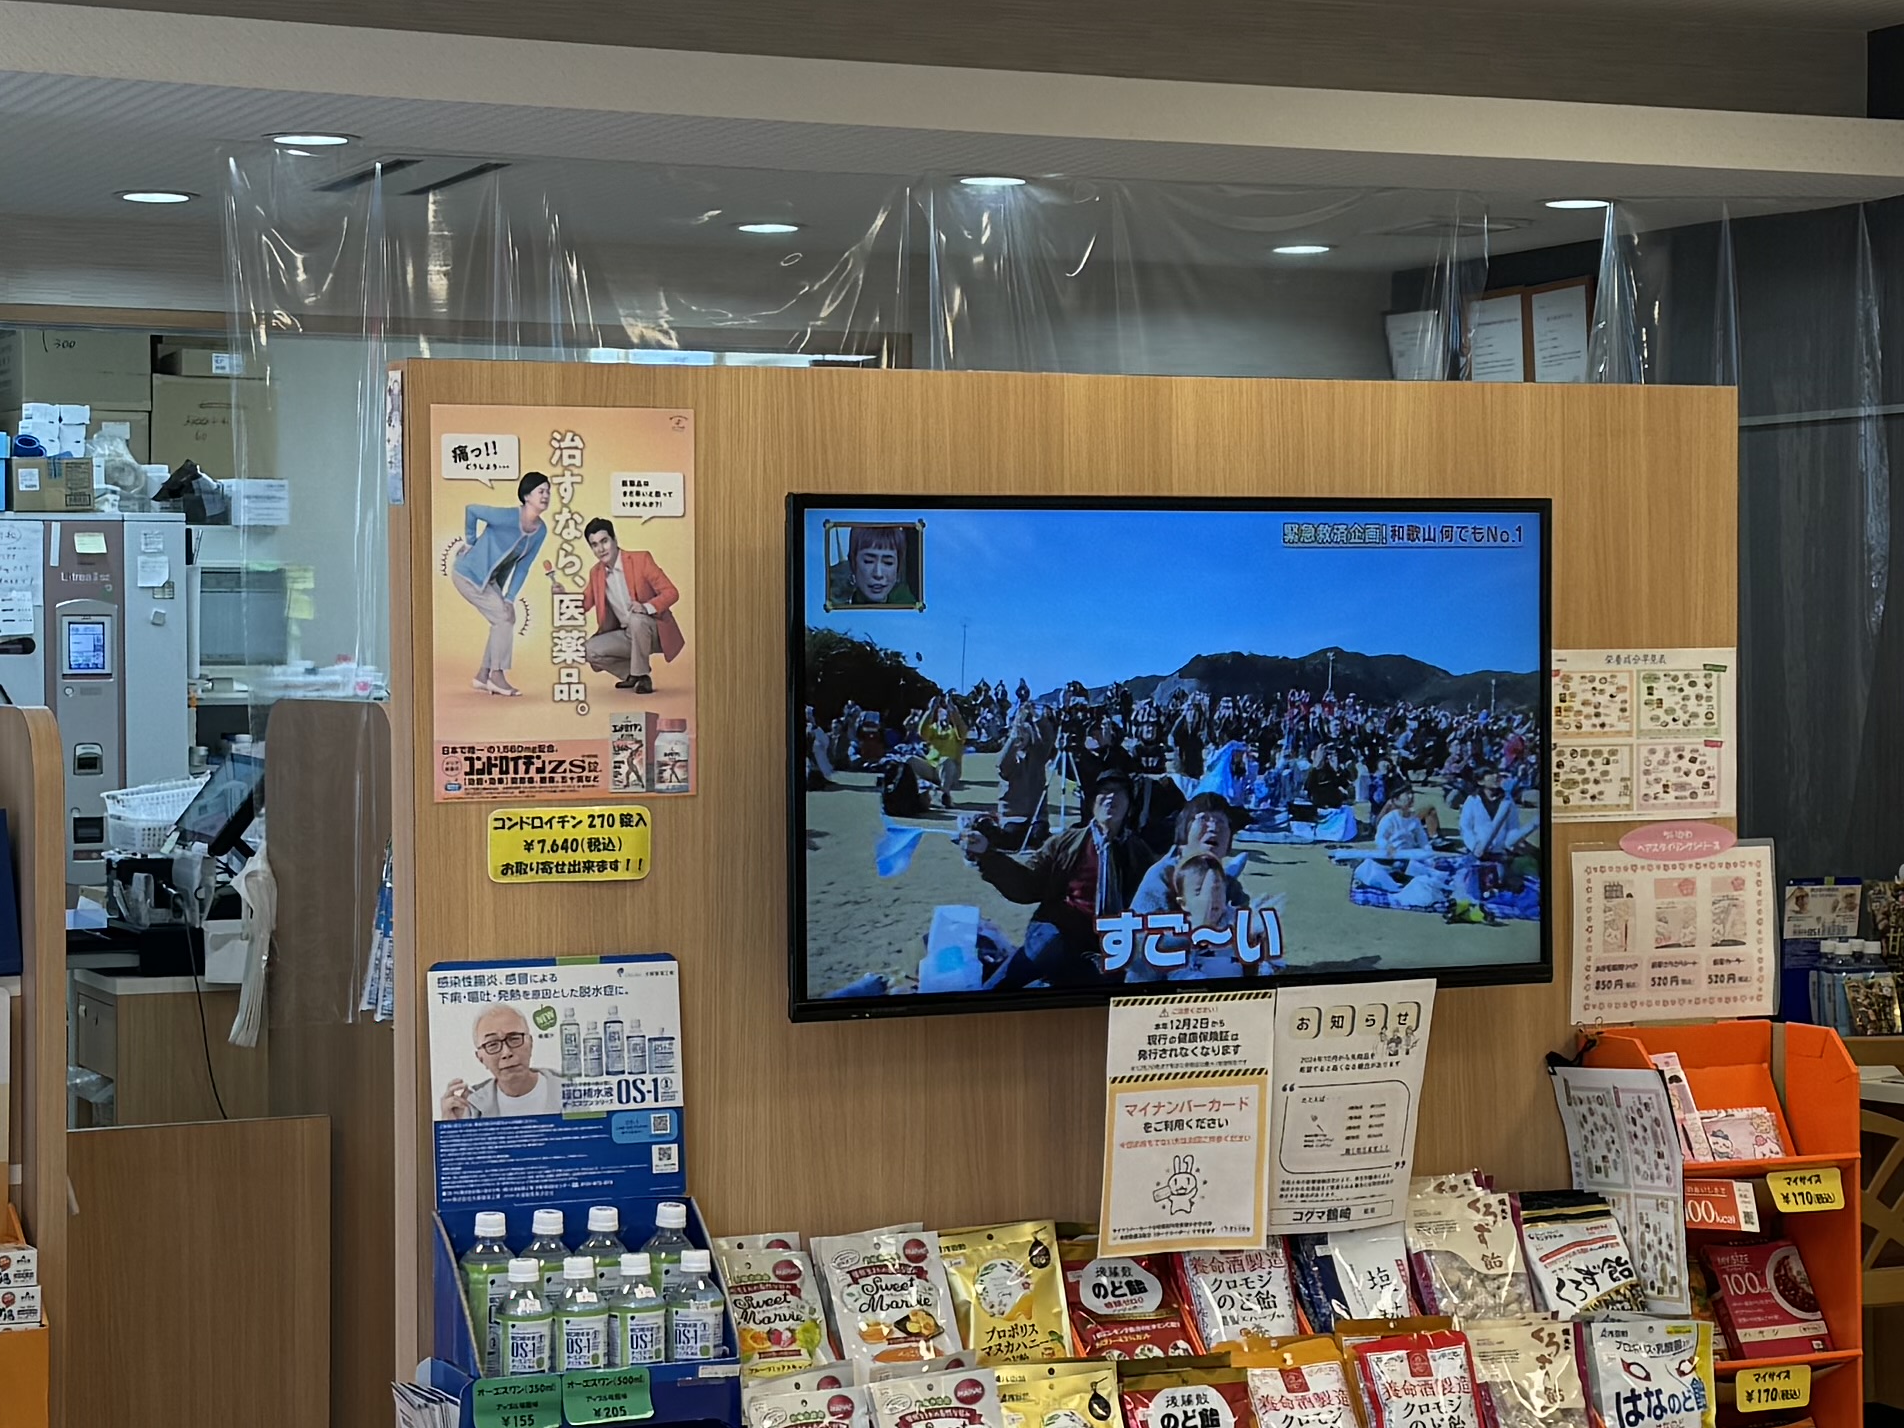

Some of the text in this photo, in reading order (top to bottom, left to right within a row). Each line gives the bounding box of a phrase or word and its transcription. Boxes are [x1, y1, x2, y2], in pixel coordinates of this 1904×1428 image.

[549, 429, 589, 716] 治すなら、医薬品。
[493, 813, 647, 831] コンドロイチン 270 錠入
[501, 858, 643, 876] お取り寄せ出来ます!!
[1297, 1011, 1410, 1032] お知らせ
[1138, 1045, 1242, 1061] 発行されなくなります
[617, 1078, 659, 1104] OS-1
[1124, 1097, 1249, 1117] マイナンバーカード
[1143, 1118, 1228, 1133] をご利用ください
[1783, 1174, 1821, 1185] マイサイズ
[861, 1277, 916, 1297] Sweet
[1092, 1279, 1148, 1299] のど飴
[1210, 1274, 1274, 1292] クロモジ
[733, 1291, 791, 1313] Sweet
[1217, 1292, 1277, 1311] のど飴
[985, 1324, 1039, 1339] プロポリス
[1753, 1371, 1791, 1382] マイサイズ
[593, 1405, 627, 1418] ¥205
[1402, 1398, 1462, 1420] クロモジ
[502, 1413, 535, 1428] ¥155
